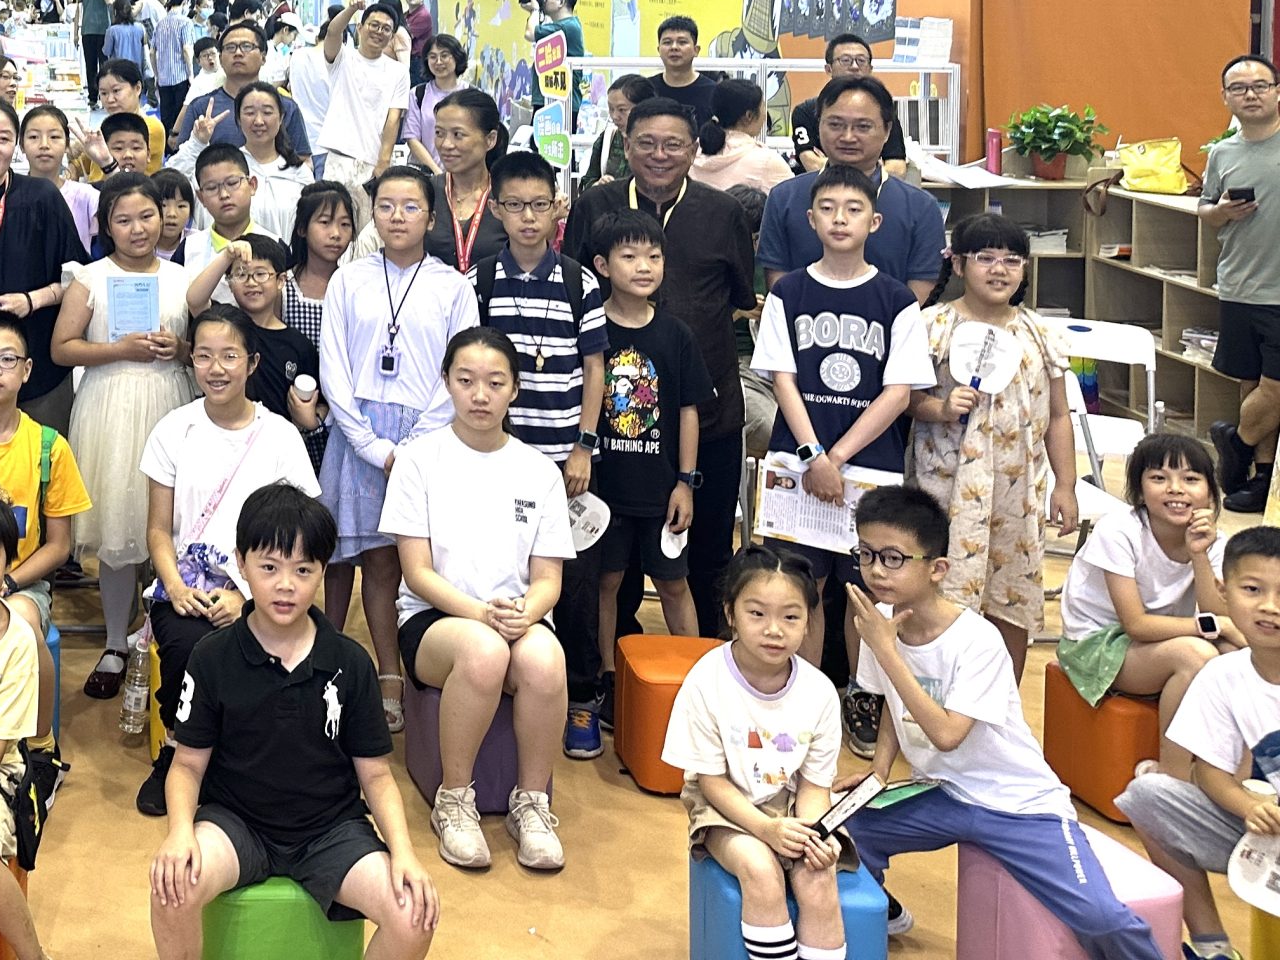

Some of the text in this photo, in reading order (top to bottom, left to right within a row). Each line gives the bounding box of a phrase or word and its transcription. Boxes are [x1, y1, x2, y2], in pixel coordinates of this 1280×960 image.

[795, 126, 810, 145] 3
[794, 311, 885, 361] BORA
[610, 438, 643, 453] BATHING
[644, 441, 660, 454] APE
